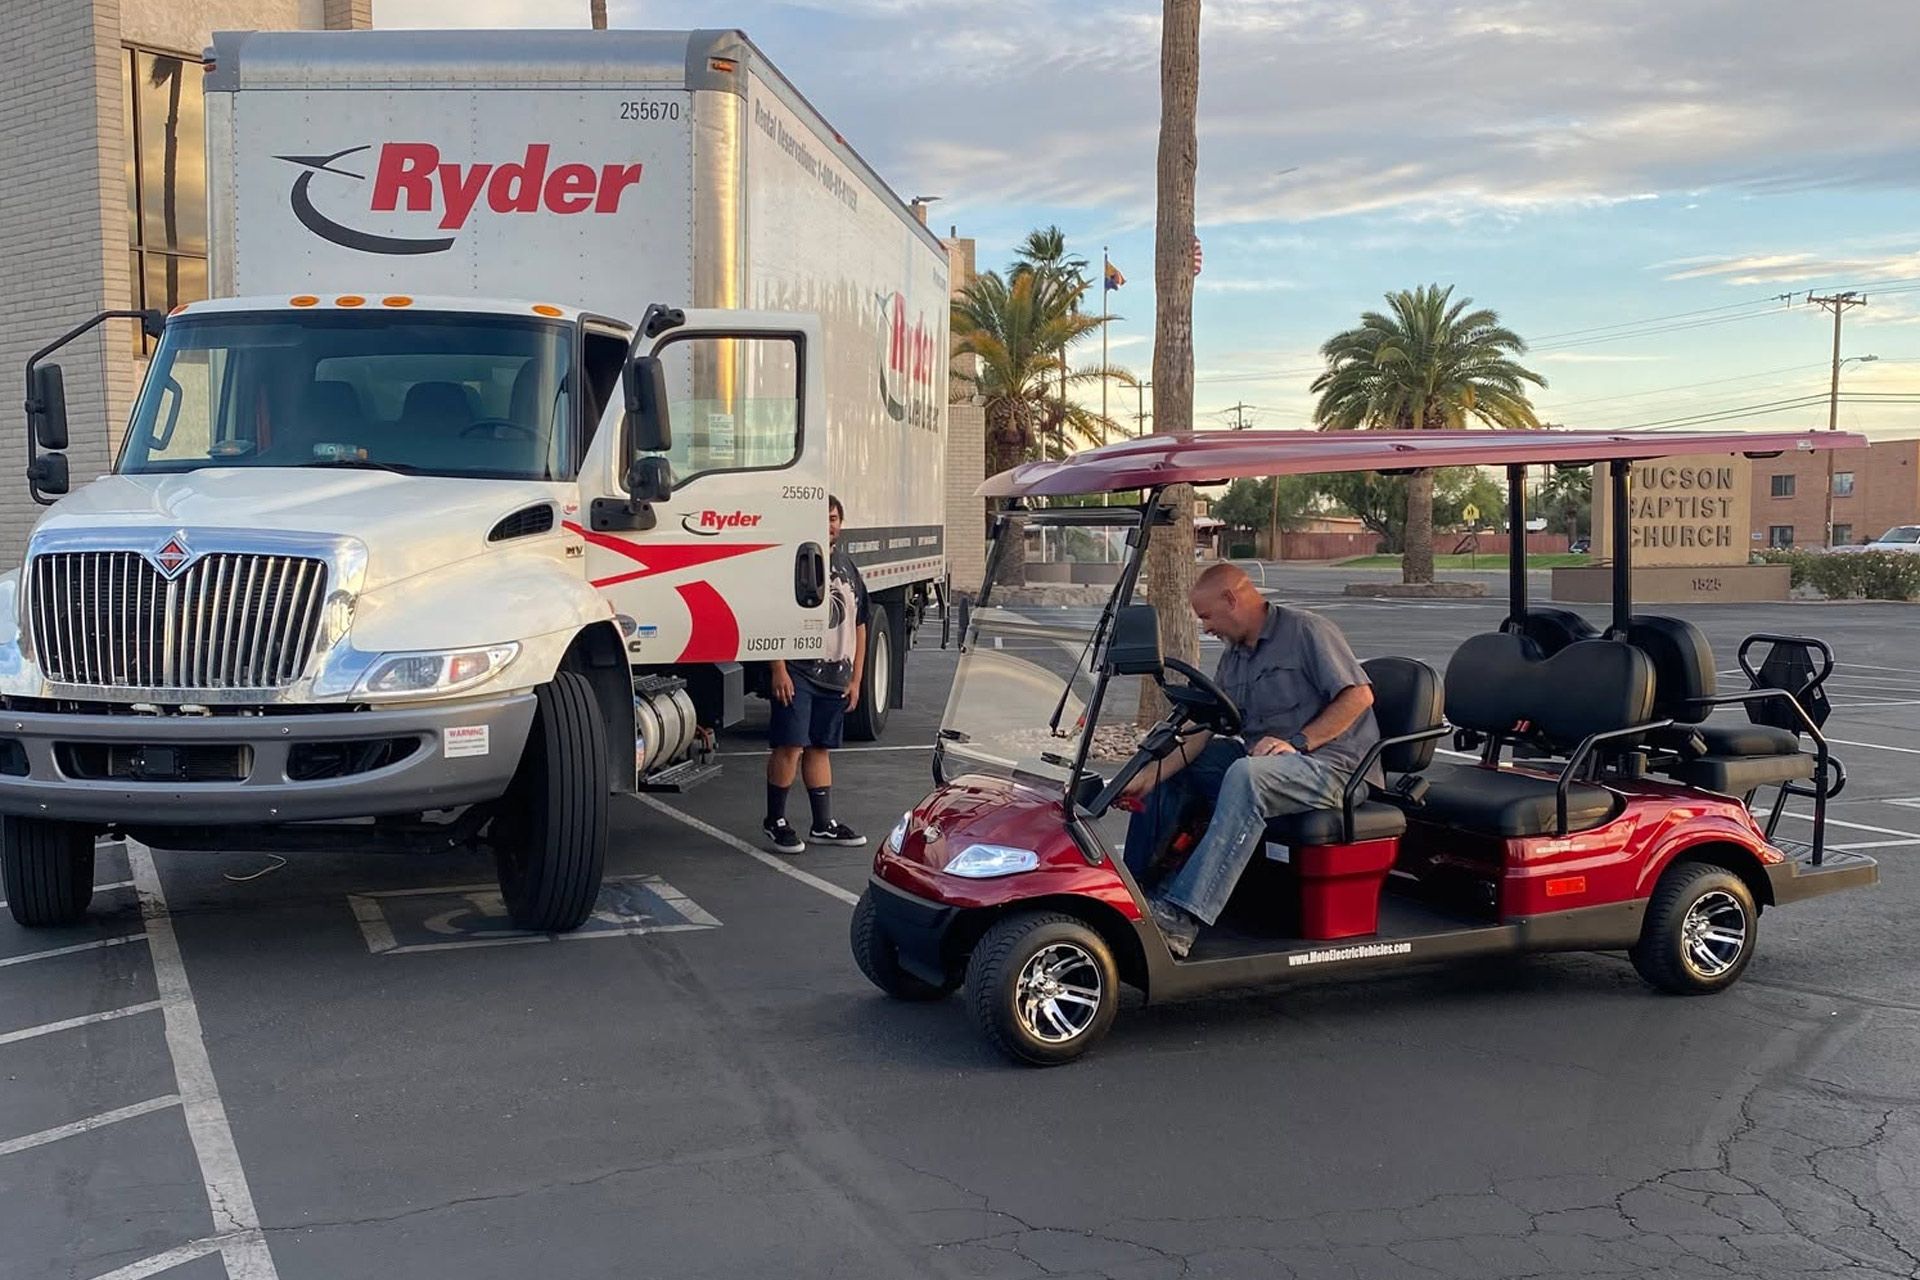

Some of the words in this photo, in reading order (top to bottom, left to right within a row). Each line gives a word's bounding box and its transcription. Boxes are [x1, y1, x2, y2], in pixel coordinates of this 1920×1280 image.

[620, 102, 680, 121] 255670
[370, 143, 643, 230] Ryder
[1631, 466, 1733, 489] TUCSON
[782, 486, 824, 500] 255670
[700, 510, 762, 530] Ryder
[1631, 525, 1732, 547] CHURCH
[566, 545, 583, 555] MV
[1692, 577, 1721, 591] 1525
[747, 638, 786, 651] USDOT
[793, 636, 822, 649] 16130
[448, 728, 484, 737] WARNING
[1288, 942, 1412, 966] www.MotoElectricVehicles.com
